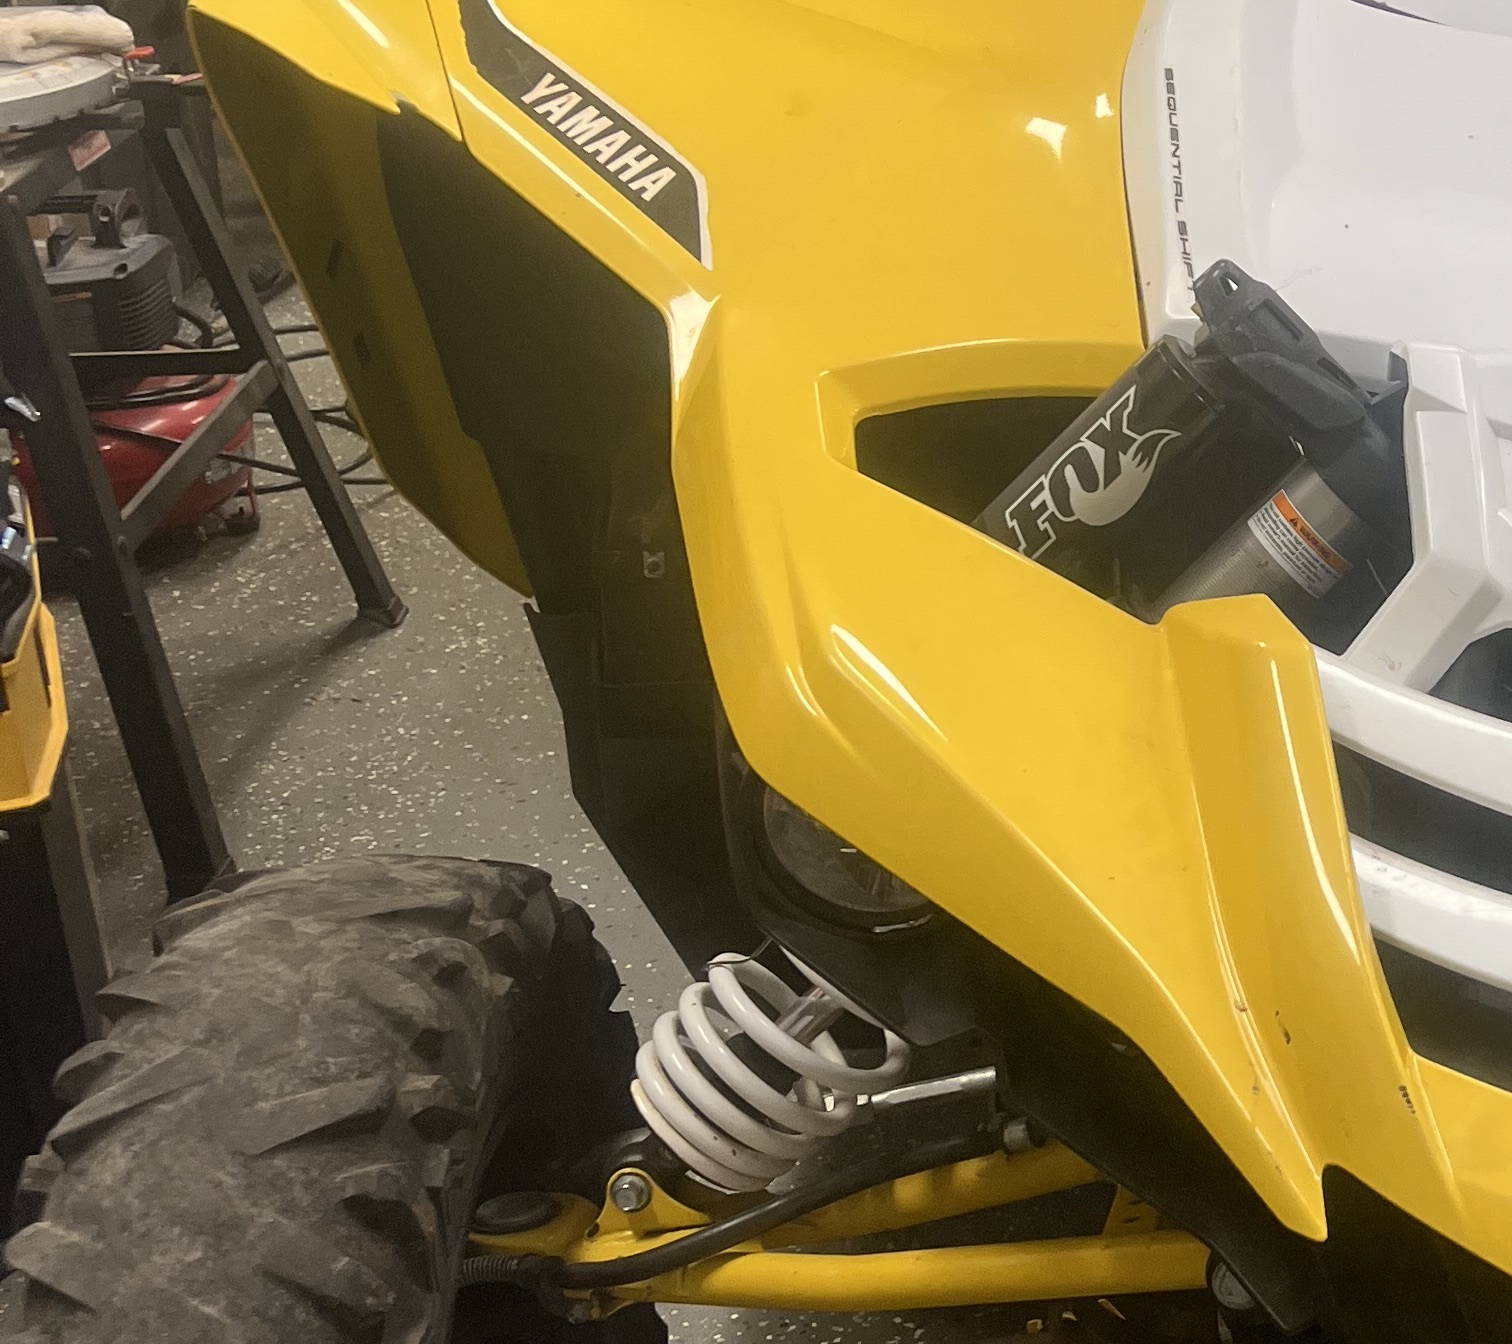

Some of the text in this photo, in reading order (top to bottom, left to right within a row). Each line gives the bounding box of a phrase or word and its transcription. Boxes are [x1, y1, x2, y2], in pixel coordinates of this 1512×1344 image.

[520, 72, 677, 202] YAMAHA
[1163, 66, 1184, 214] SEQUENTIAL
[1005, 384, 1143, 560] FOX
